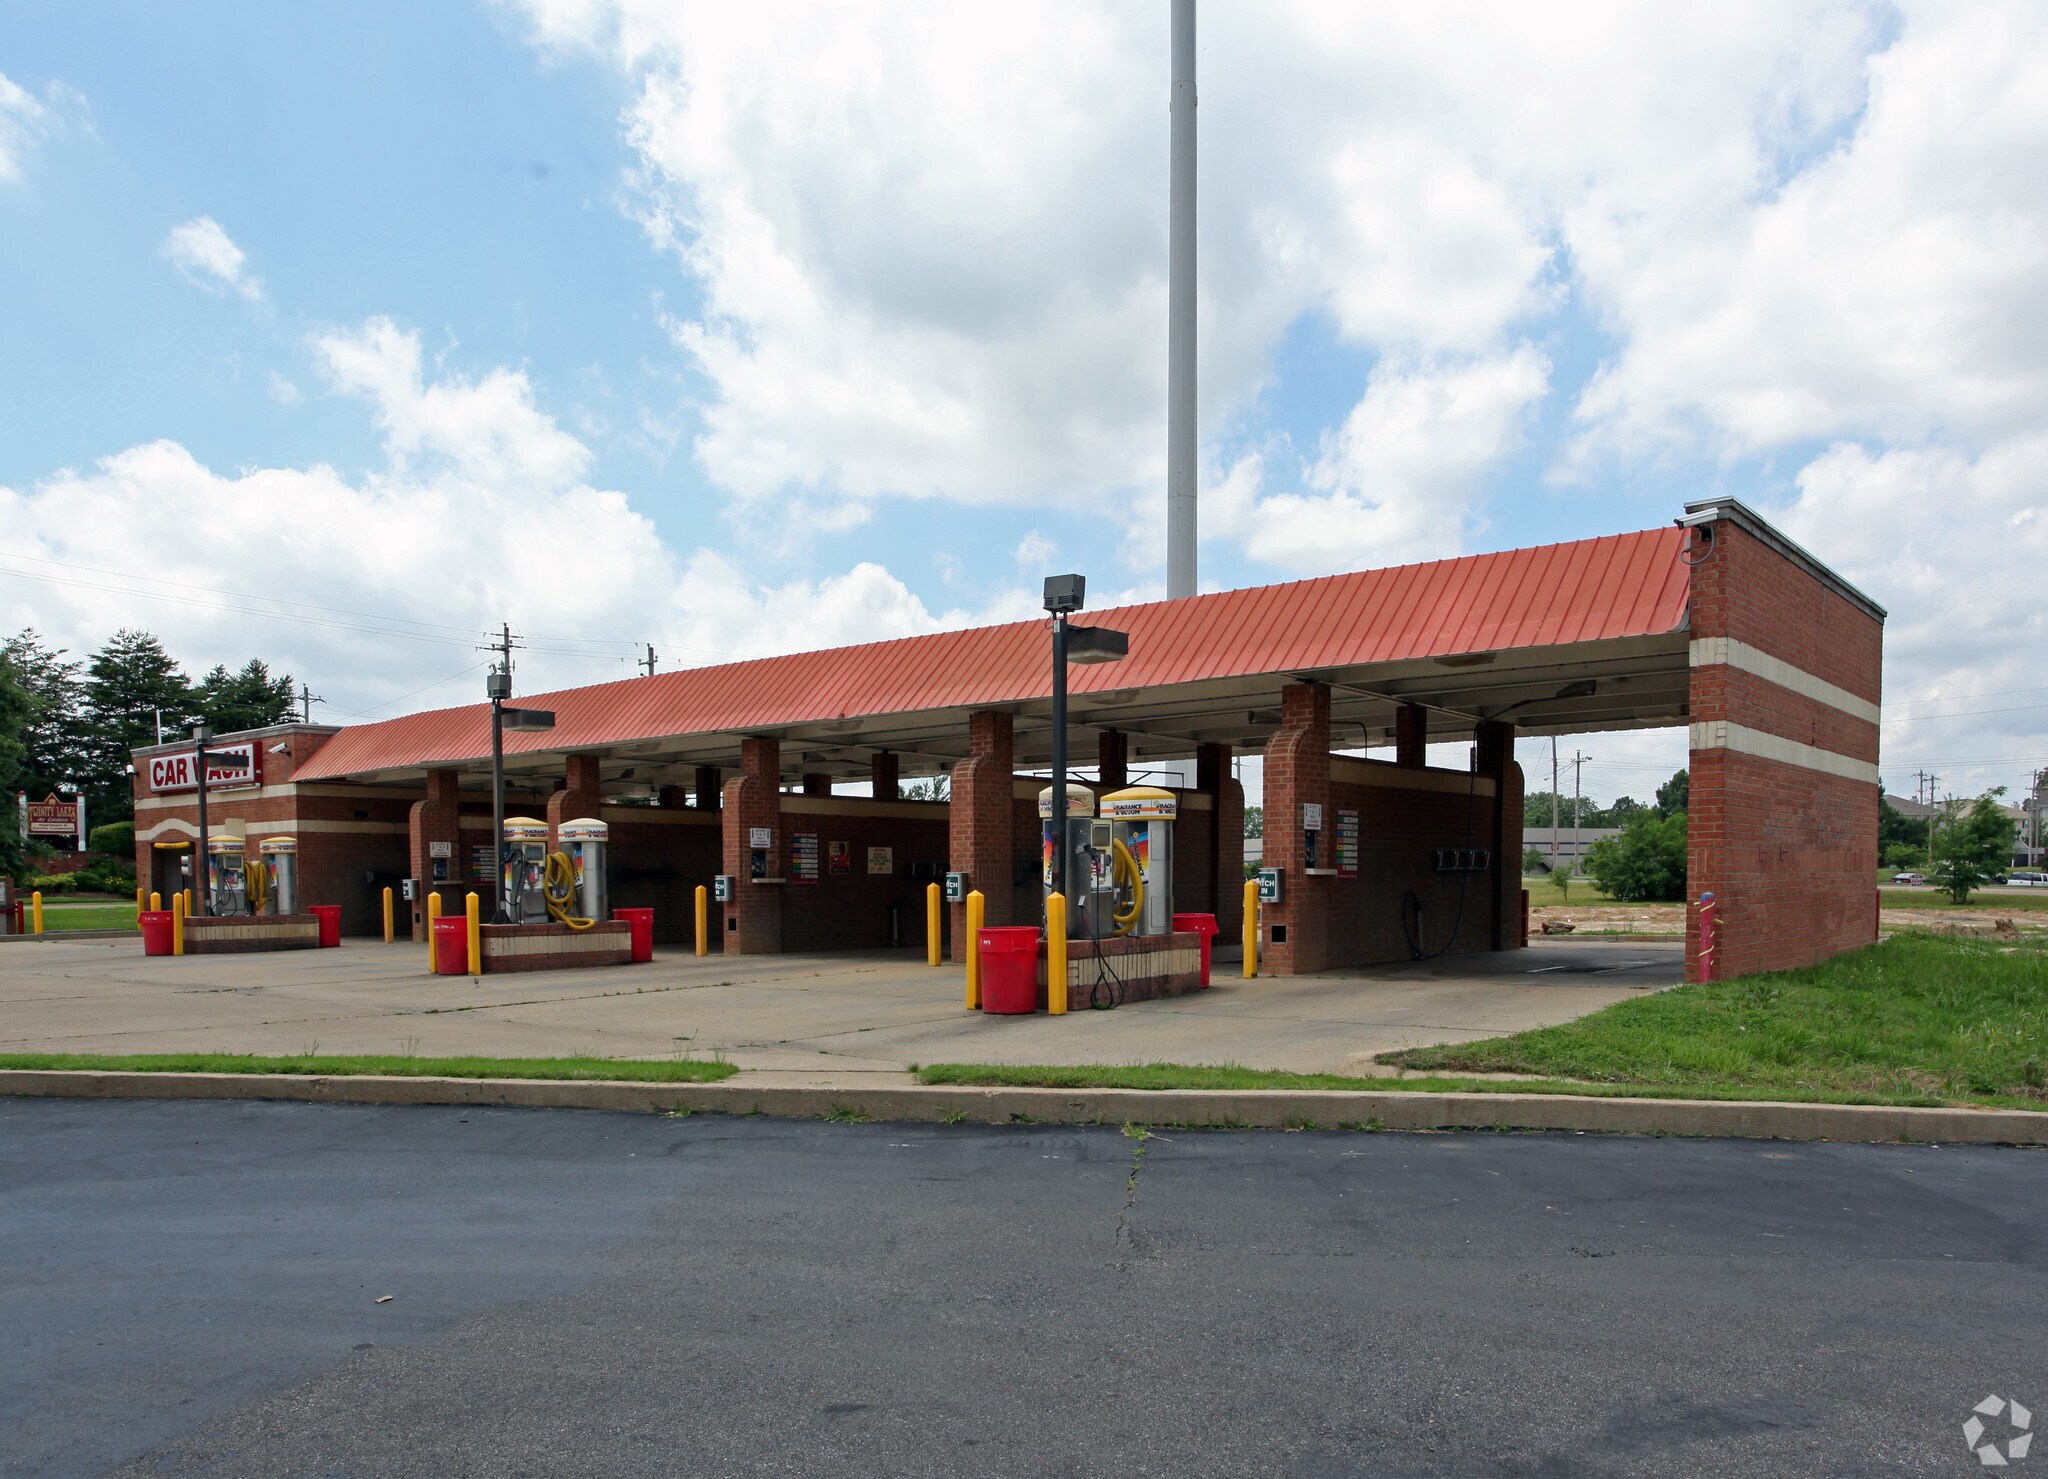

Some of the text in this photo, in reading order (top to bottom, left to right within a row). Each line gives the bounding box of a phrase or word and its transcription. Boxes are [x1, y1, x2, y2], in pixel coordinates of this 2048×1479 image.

[153, 758, 188, 786] CAR
[29, 806, 76, 822] TRINITY LAKES
